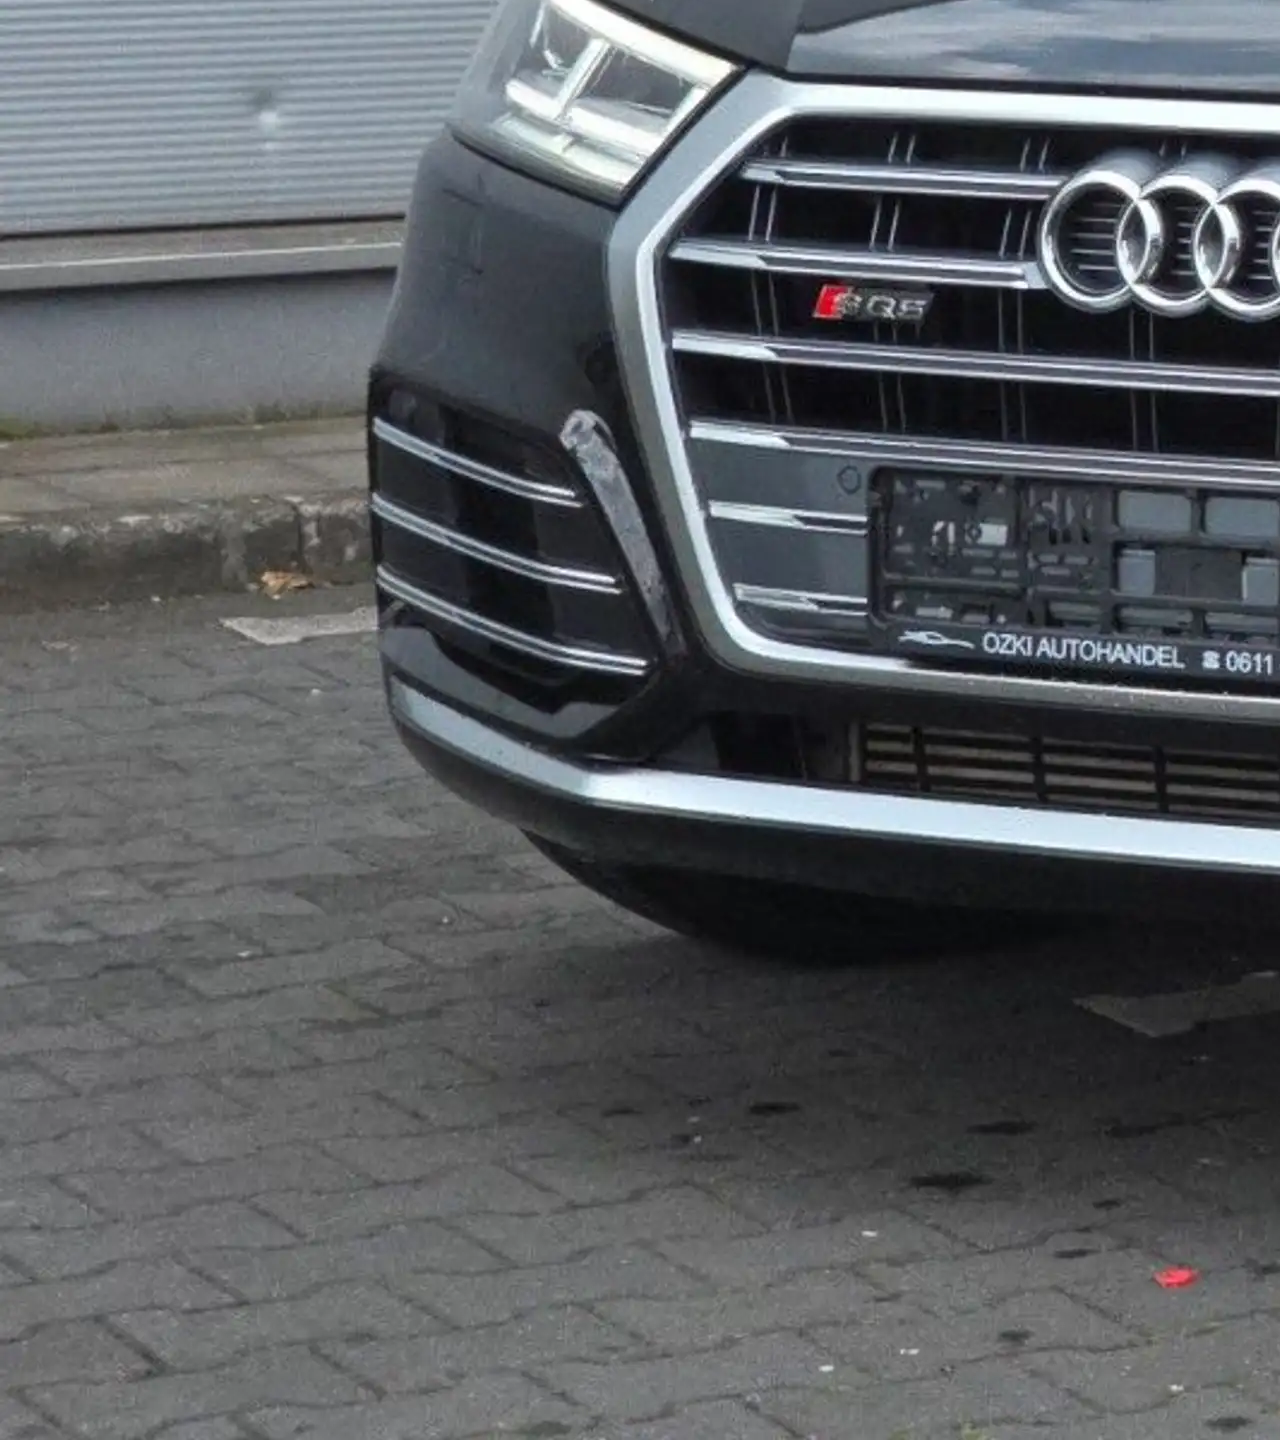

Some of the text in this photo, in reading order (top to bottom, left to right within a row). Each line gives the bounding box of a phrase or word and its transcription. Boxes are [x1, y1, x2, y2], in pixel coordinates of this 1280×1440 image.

[982, 631, 1034, 657] OZKI
[1036, 637, 1186, 669] AUTOHANDEL
[1225, 650, 1274, 675] 0611
